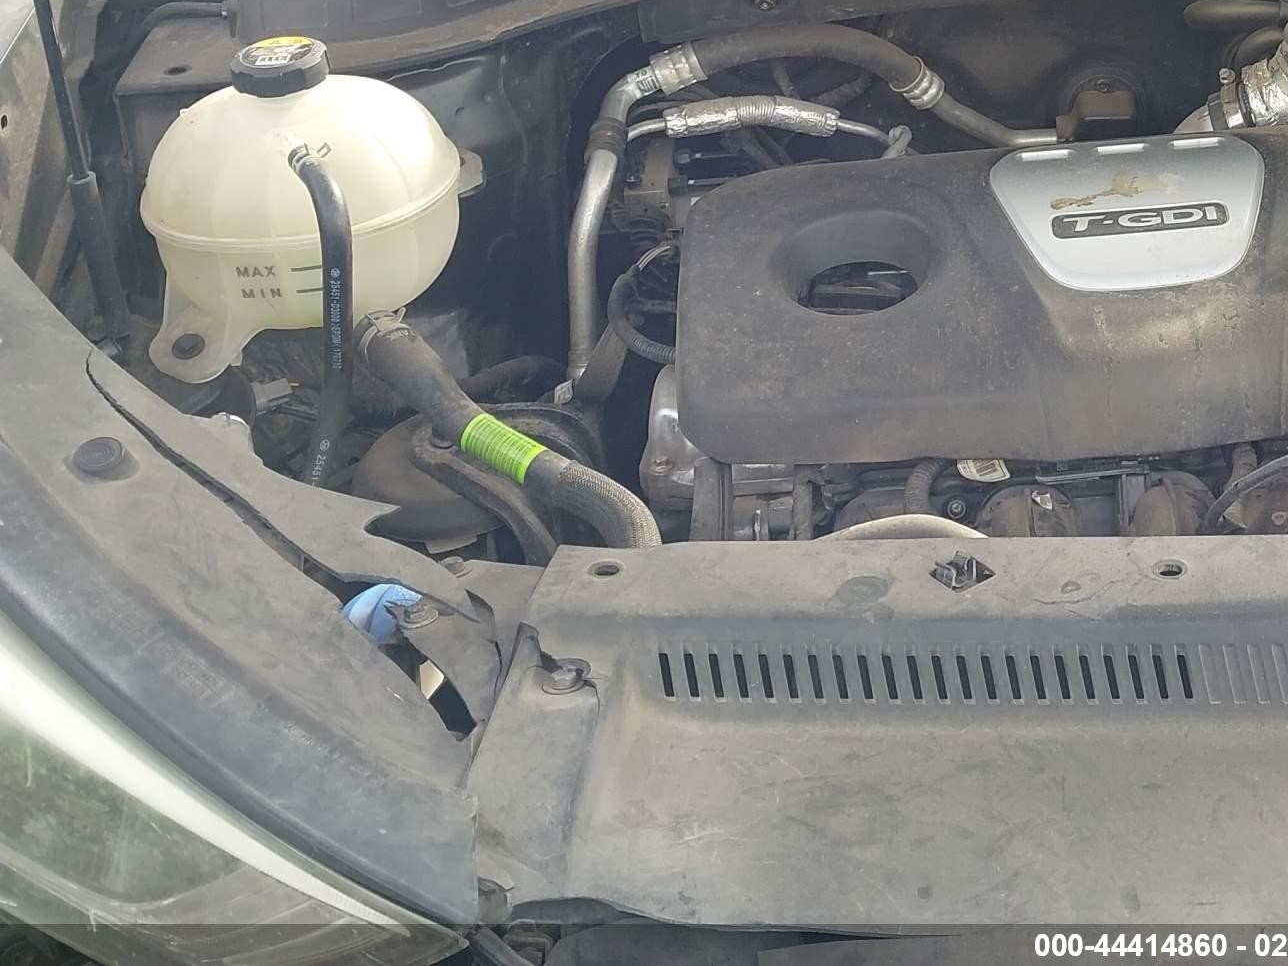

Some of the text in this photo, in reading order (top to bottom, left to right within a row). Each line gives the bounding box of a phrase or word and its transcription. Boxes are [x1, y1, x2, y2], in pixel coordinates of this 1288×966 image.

[1063, 206, 1219, 232] T-GDI
[236, 266, 276, 277] MAX
[241, 288, 282, 298] MIN
